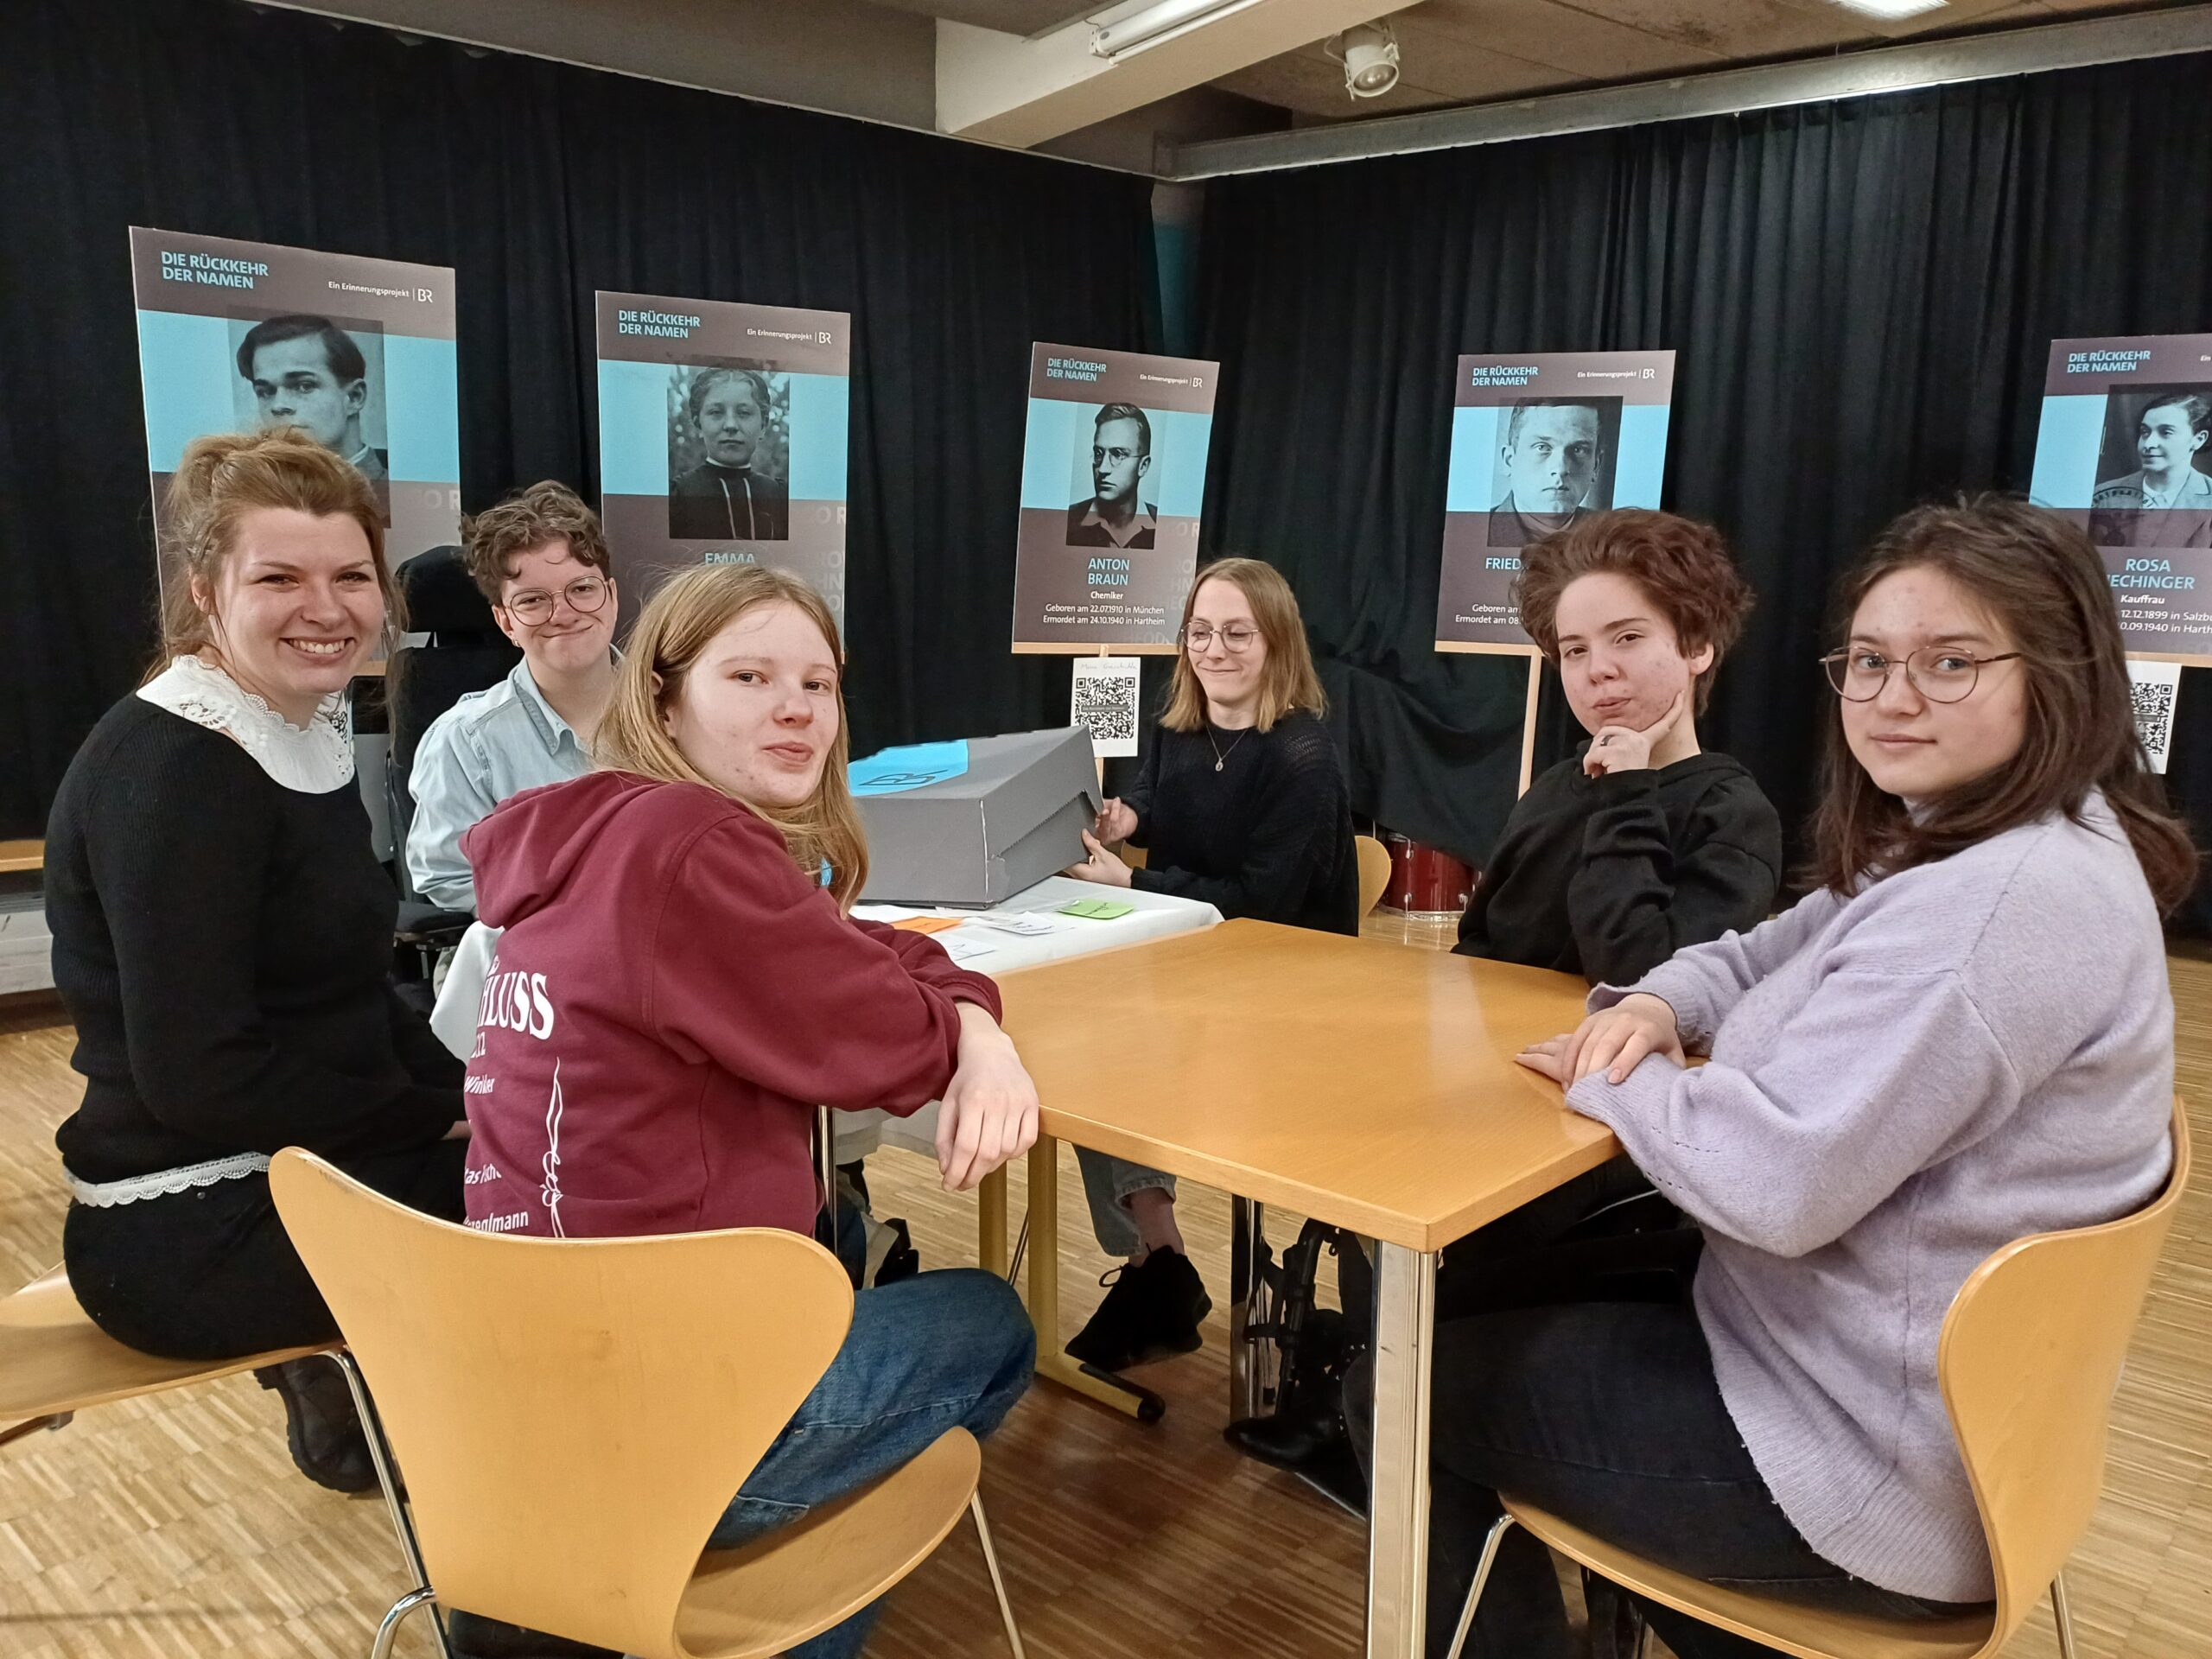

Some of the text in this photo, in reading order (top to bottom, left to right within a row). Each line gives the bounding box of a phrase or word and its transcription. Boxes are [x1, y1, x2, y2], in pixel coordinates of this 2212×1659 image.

[161, 251, 269, 276] DIE RÜCKKEHR
[162, 266, 254, 289] DER NAMEN
[328, 281, 433, 303] Ein Erinnerungsprojekt BR
[619, 310, 701, 327] DIE RÜCKKEHR
[619, 322, 689, 339] DER NAMEN
[758, 329, 812, 340] Erinnerungsprojekt
[818, 332, 831, 344] BR
[2069, 350, 2151, 362] DIE RÜCKKEHR
[1047, 358, 1107, 372] DIE RÜCKKEHR
[1472, 365, 1538, 376] DIE RÜCKKEHR
[2067, 361, 2137, 373] DER NAMEN
[1046, 368, 1097, 382] DER NAMEN
[1643, 368, 1655, 379] BR
[1192, 377, 1203, 388] BR
[1471, 377, 1528, 386] DER NAMEN
[705, 552, 754, 564] EMMA
[1088, 557, 1130, 571] ANTON
[1485, 557, 1522, 570] FRIED
[2126, 558, 2171, 572] ROSA
[1088, 573, 1128, 586] BRAUN
[1090, 591, 1123, 600] Chemiker
[2120, 594, 2165, 604] Kauffrau
[1045, 603, 1076, 613] Geboren
[1124, 606, 1132, 614] in
[1133, 606, 1164, 614] München
[1471, 603, 1506, 613] Geboren
[1043, 614, 1076, 624] Ermordet
[1090, 616, 1124, 625] 24.10.1940
[1125, 617, 1133, 626] in
[1134, 617, 1166, 626] Hartheim
[1455, 614, 1491, 623] Ermordet
[1508, 616, 1522, 625] 08.
[2171, 611, 2180, 620] in
[2119, 622, 2169, 632] 0.09.1940
[2171, 623, 2180, 632] in
